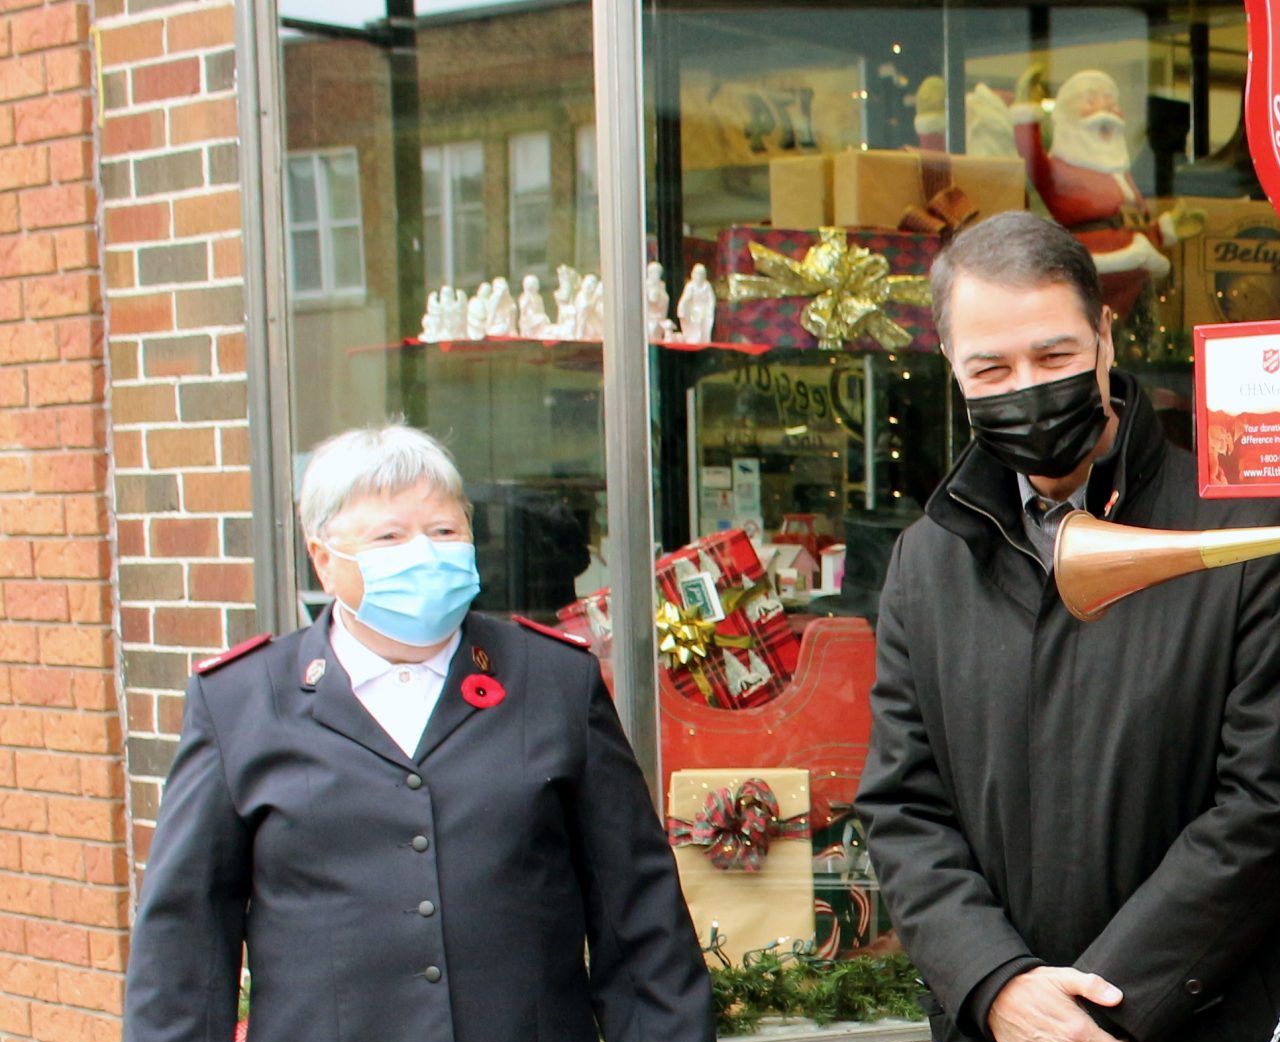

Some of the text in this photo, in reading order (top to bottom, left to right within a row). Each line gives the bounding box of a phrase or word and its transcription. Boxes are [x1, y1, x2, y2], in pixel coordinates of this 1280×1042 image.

[1244, 424, 1259, 433] Your
[1241, 435, 1273, 445] difference
[1274, 435, 1280, 443] in
